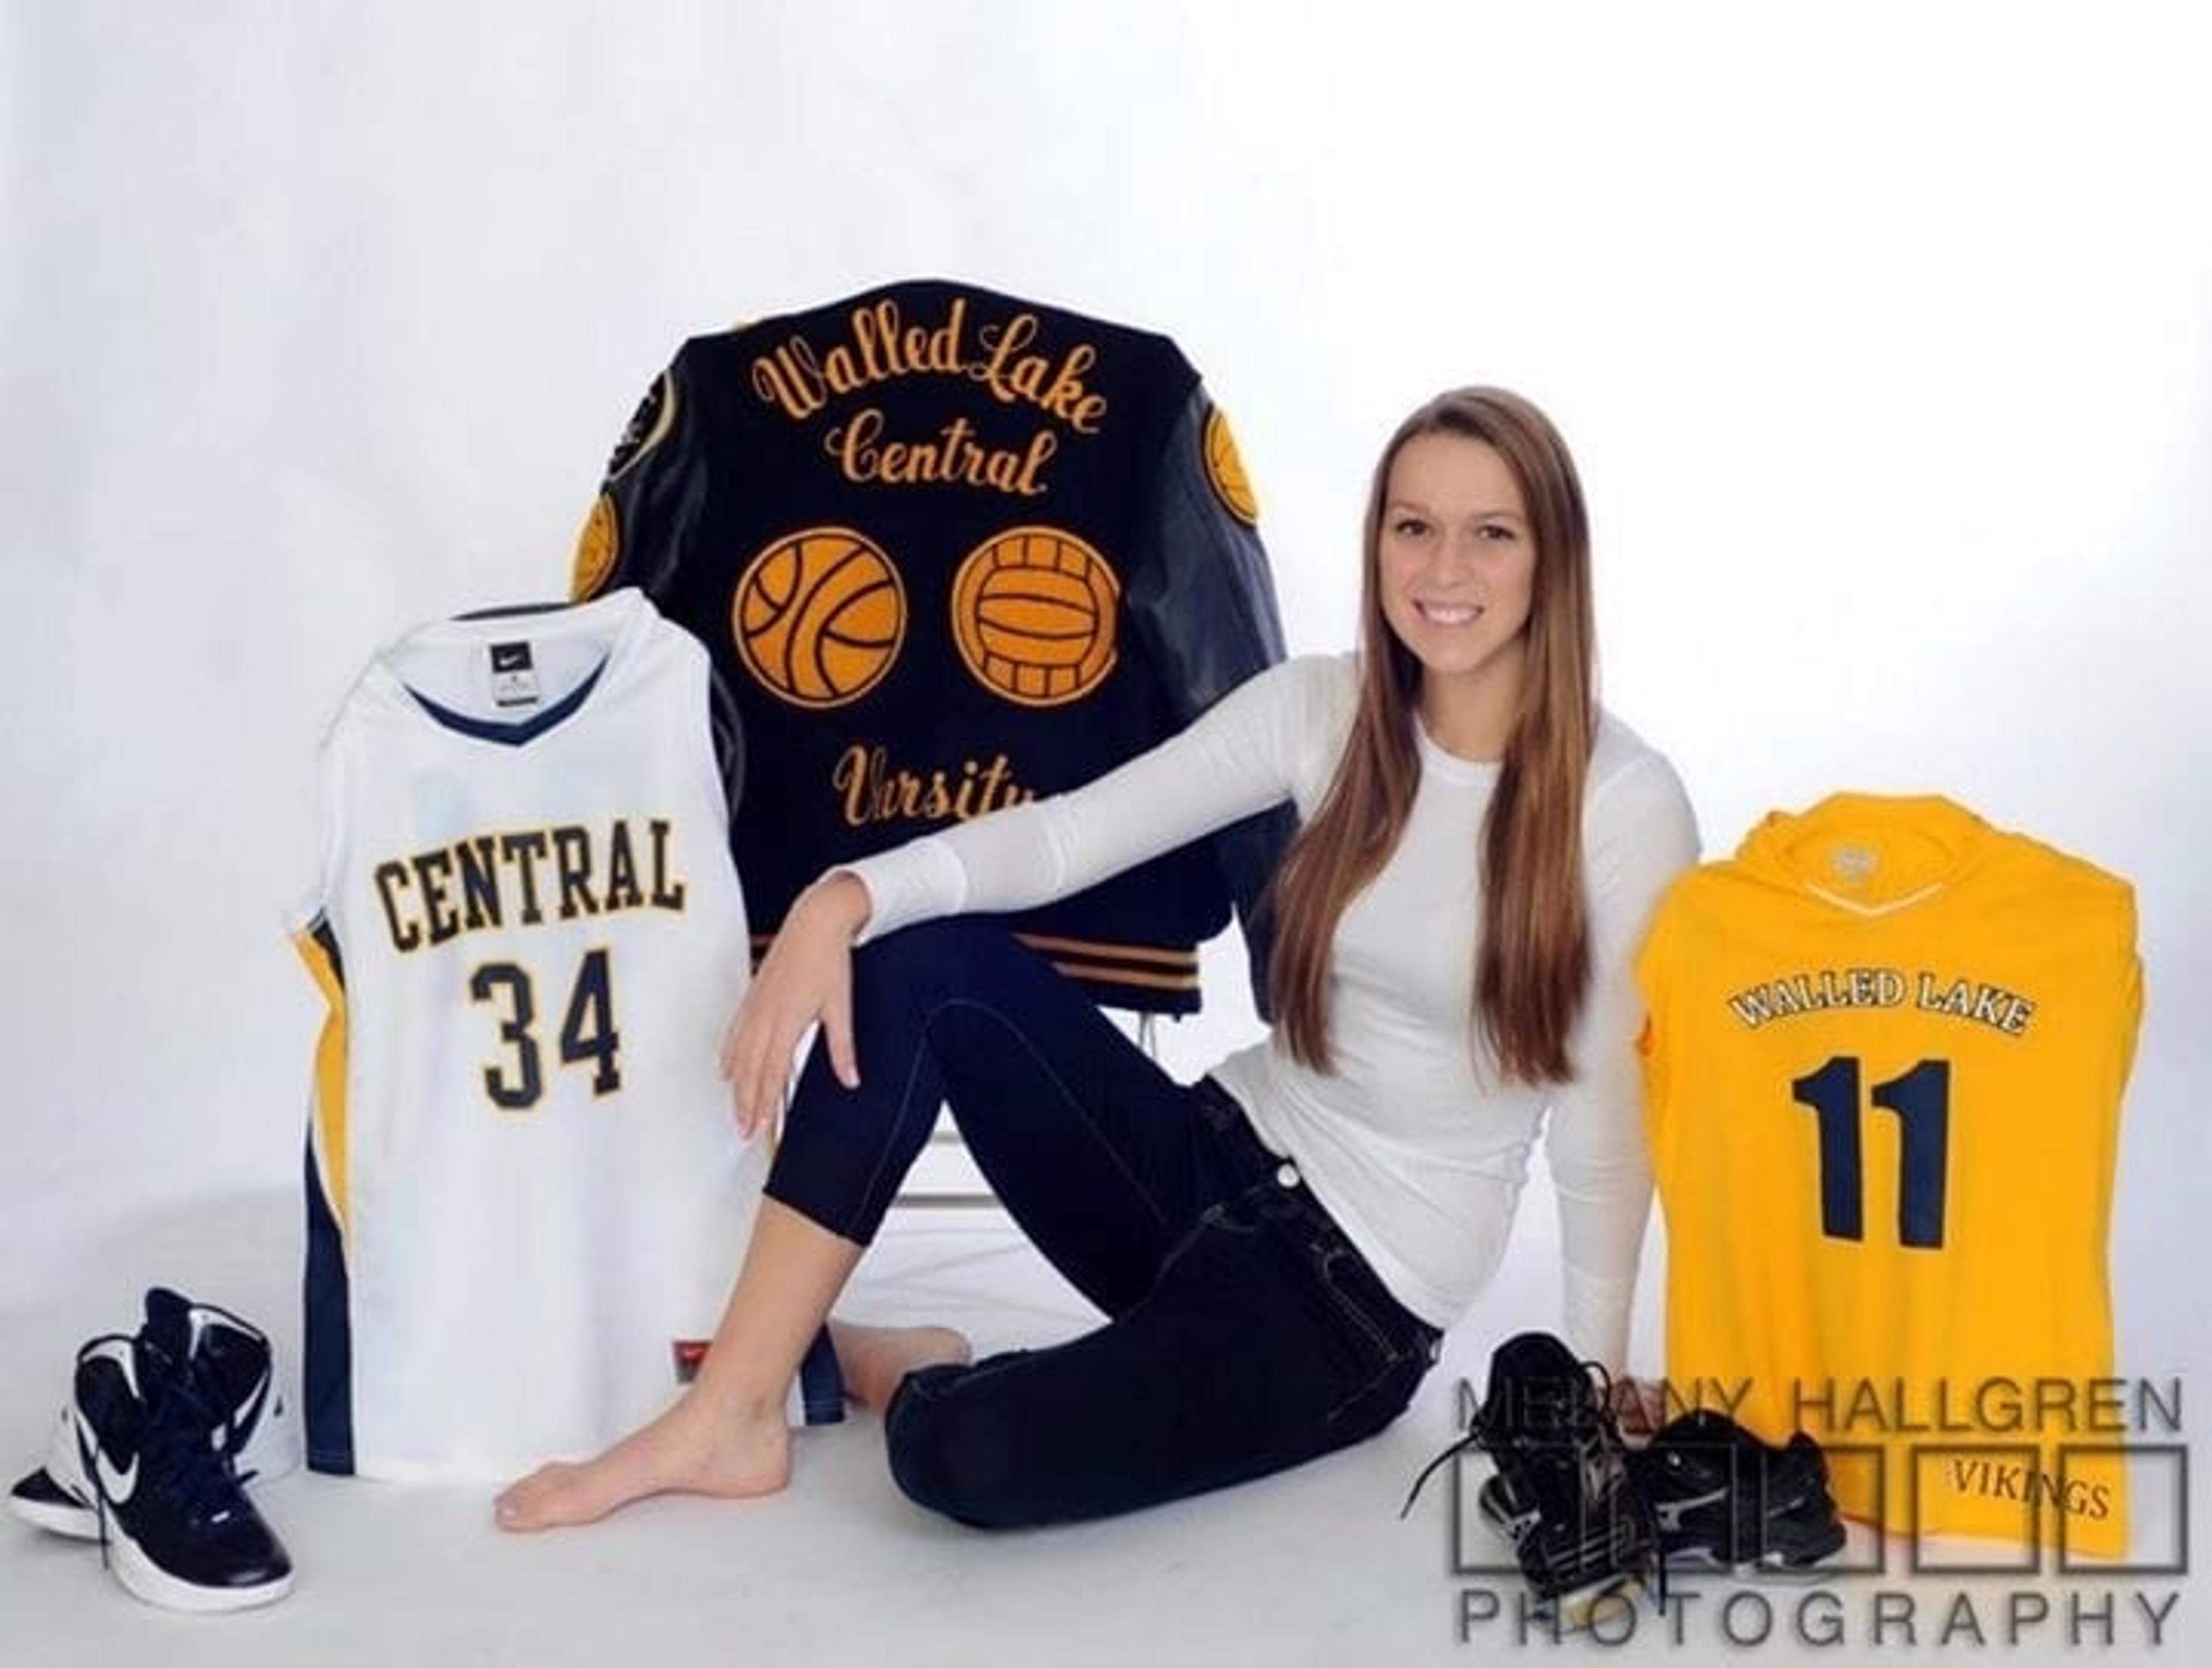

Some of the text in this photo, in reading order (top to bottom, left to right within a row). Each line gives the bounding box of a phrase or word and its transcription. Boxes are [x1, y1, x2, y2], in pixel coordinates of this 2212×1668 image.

[752, 297, 1107, 434] Walled Lake
[824, 408, 1058, 495] Central
[372, 817, 689, 957] CENTRAL
[467, 945, 624, 1114] 34
[1729, 969, 2036, 1036] WALLED LAKE
[1791, 1055, 1950, 1250] 11
[1952, 1459, 2111, 1521] VIKINGS
